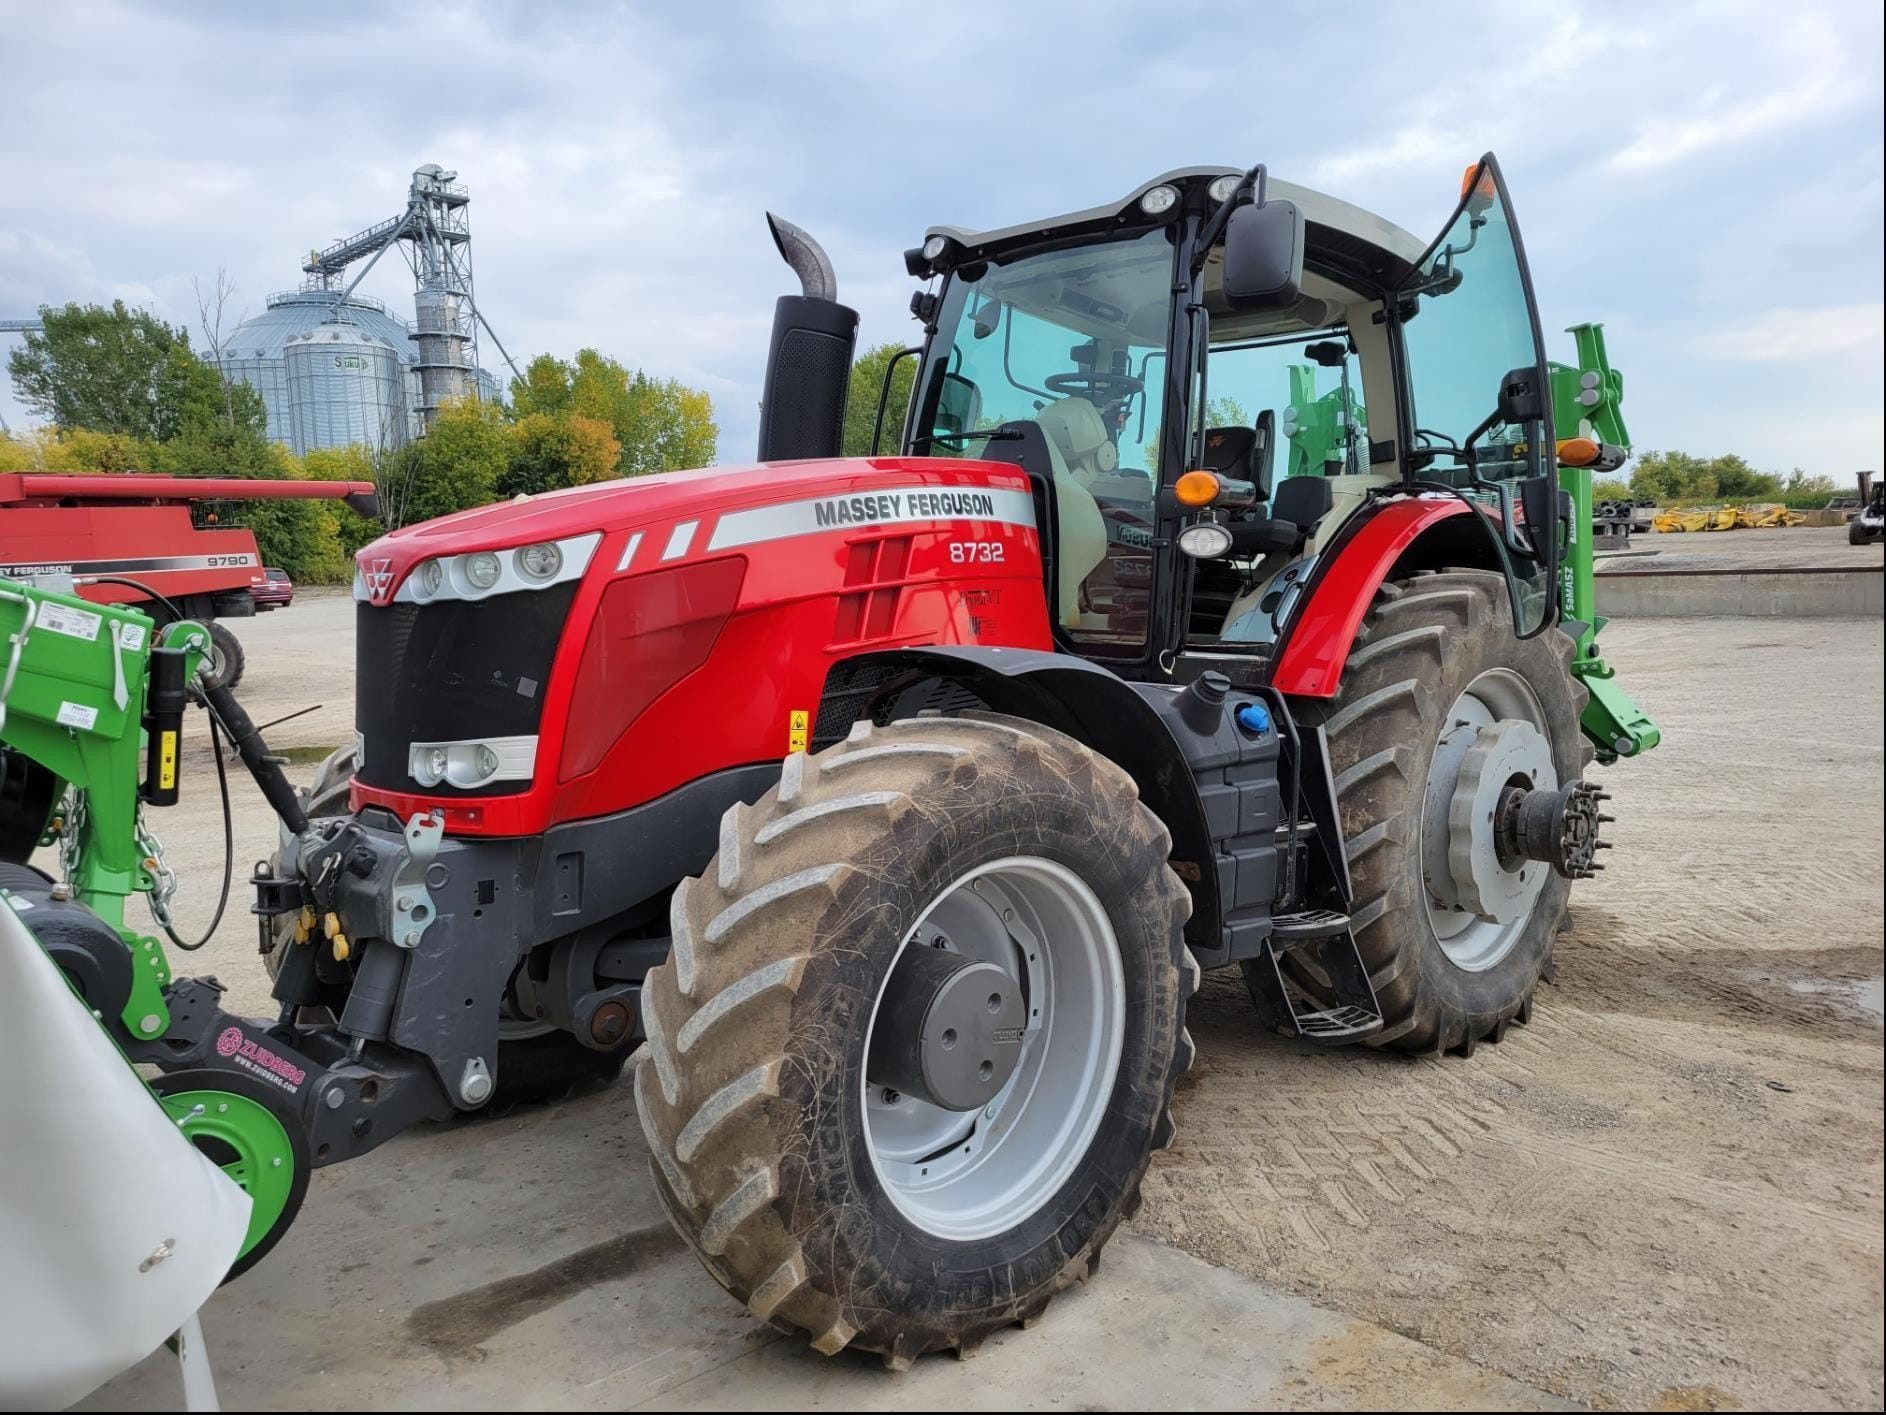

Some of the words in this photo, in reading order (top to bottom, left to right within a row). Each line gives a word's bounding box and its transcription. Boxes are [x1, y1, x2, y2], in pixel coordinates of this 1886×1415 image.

[814, 494, 902, 528] MASSEY
[908, 491, 994, 518] FERGUSON
[14, 564, 72, 575] FERGUSON
[207, 556, 248, 567] 9790
[948, 541, 1005, 564] 8732
[1564, 566, 1575, 612] SaMASZ
[233, 1054, 298, 1094] WWW.ZUIDBERG.COM
[239, 1038, 306, 1085] ZUIDBERG
